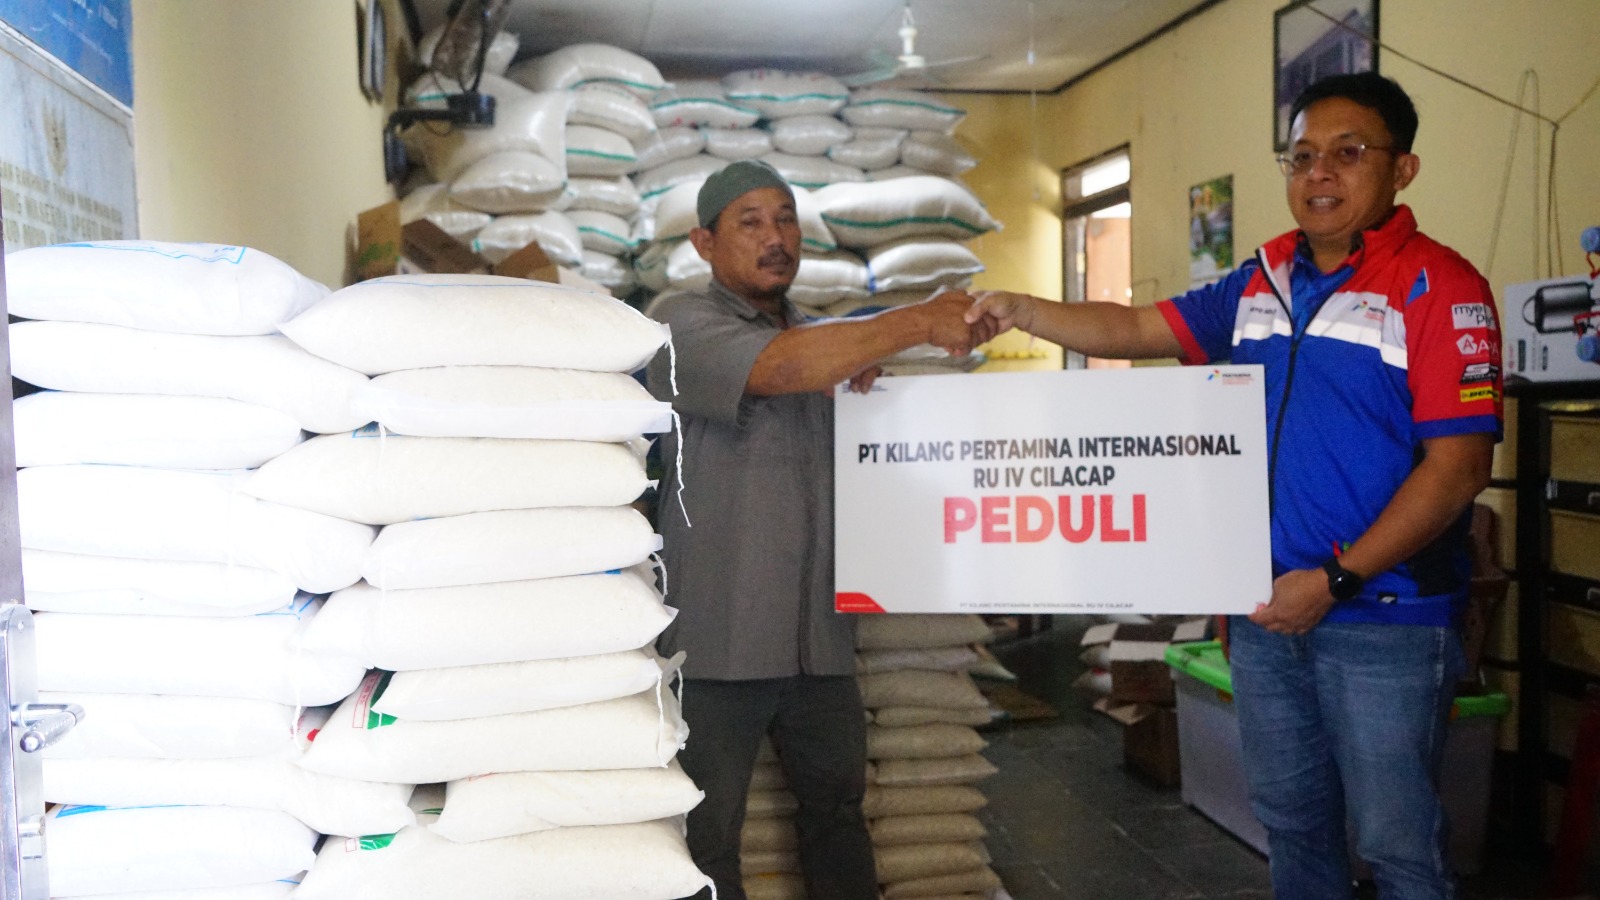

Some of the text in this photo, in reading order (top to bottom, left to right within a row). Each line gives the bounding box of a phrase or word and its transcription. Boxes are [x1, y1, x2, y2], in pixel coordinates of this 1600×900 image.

[858, 434, 1241, 463] PT KILANG PERTAMINA INTERNASIONAL
[974, 465, 1116, 488] RU IV CILACAP
[944, 494, 1147, 543] PEDULI
